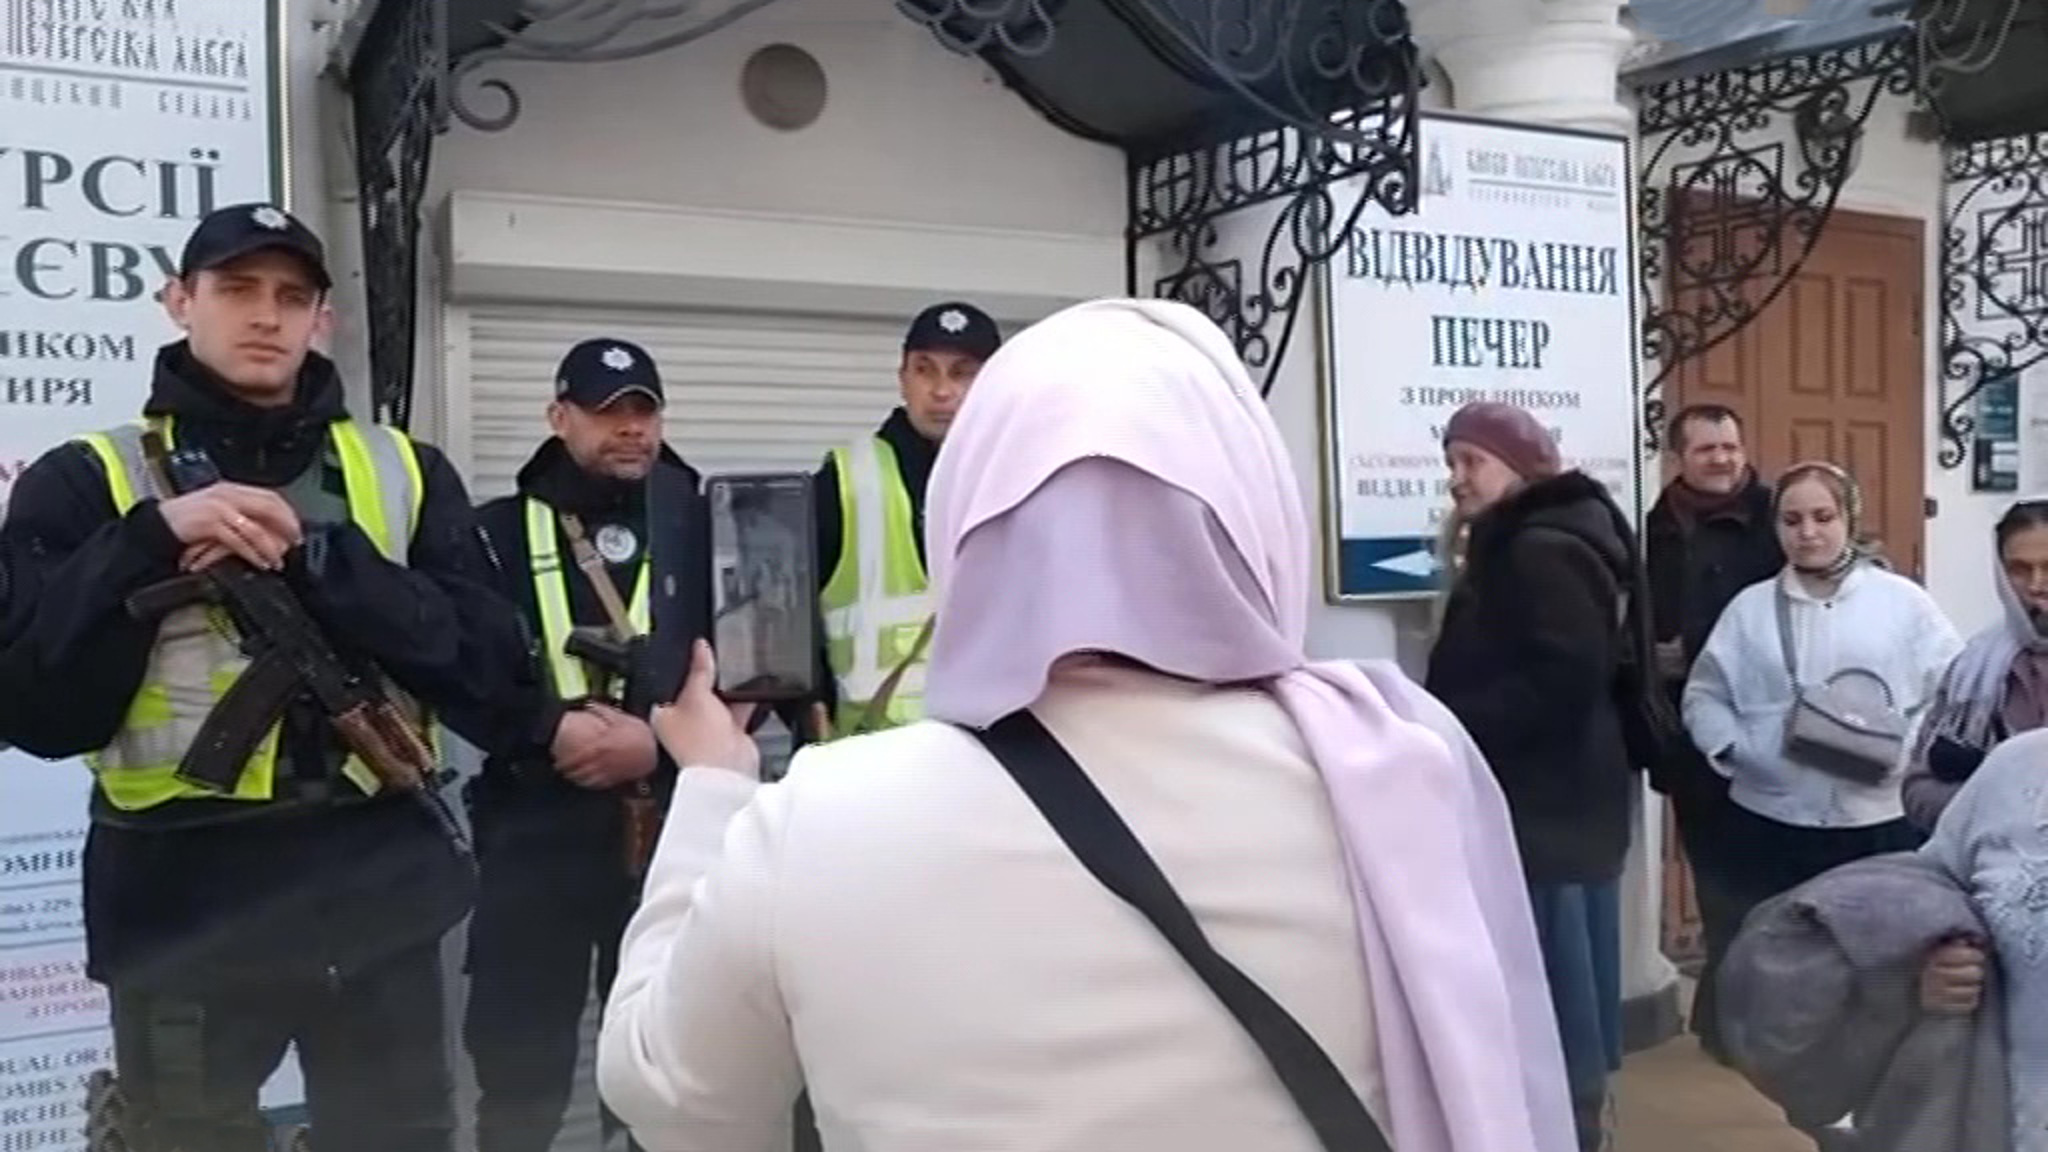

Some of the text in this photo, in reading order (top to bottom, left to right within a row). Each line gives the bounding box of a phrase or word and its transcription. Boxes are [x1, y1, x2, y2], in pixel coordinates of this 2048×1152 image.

[0, 147, 222, 221] РСІЇ
[1347, 225, 1619, 296] ВІДВІДУВАННЯ
[1431, 314, 1550, 369] ПЕЧЕР
[0, 376, 93, 406] ИРЯ
